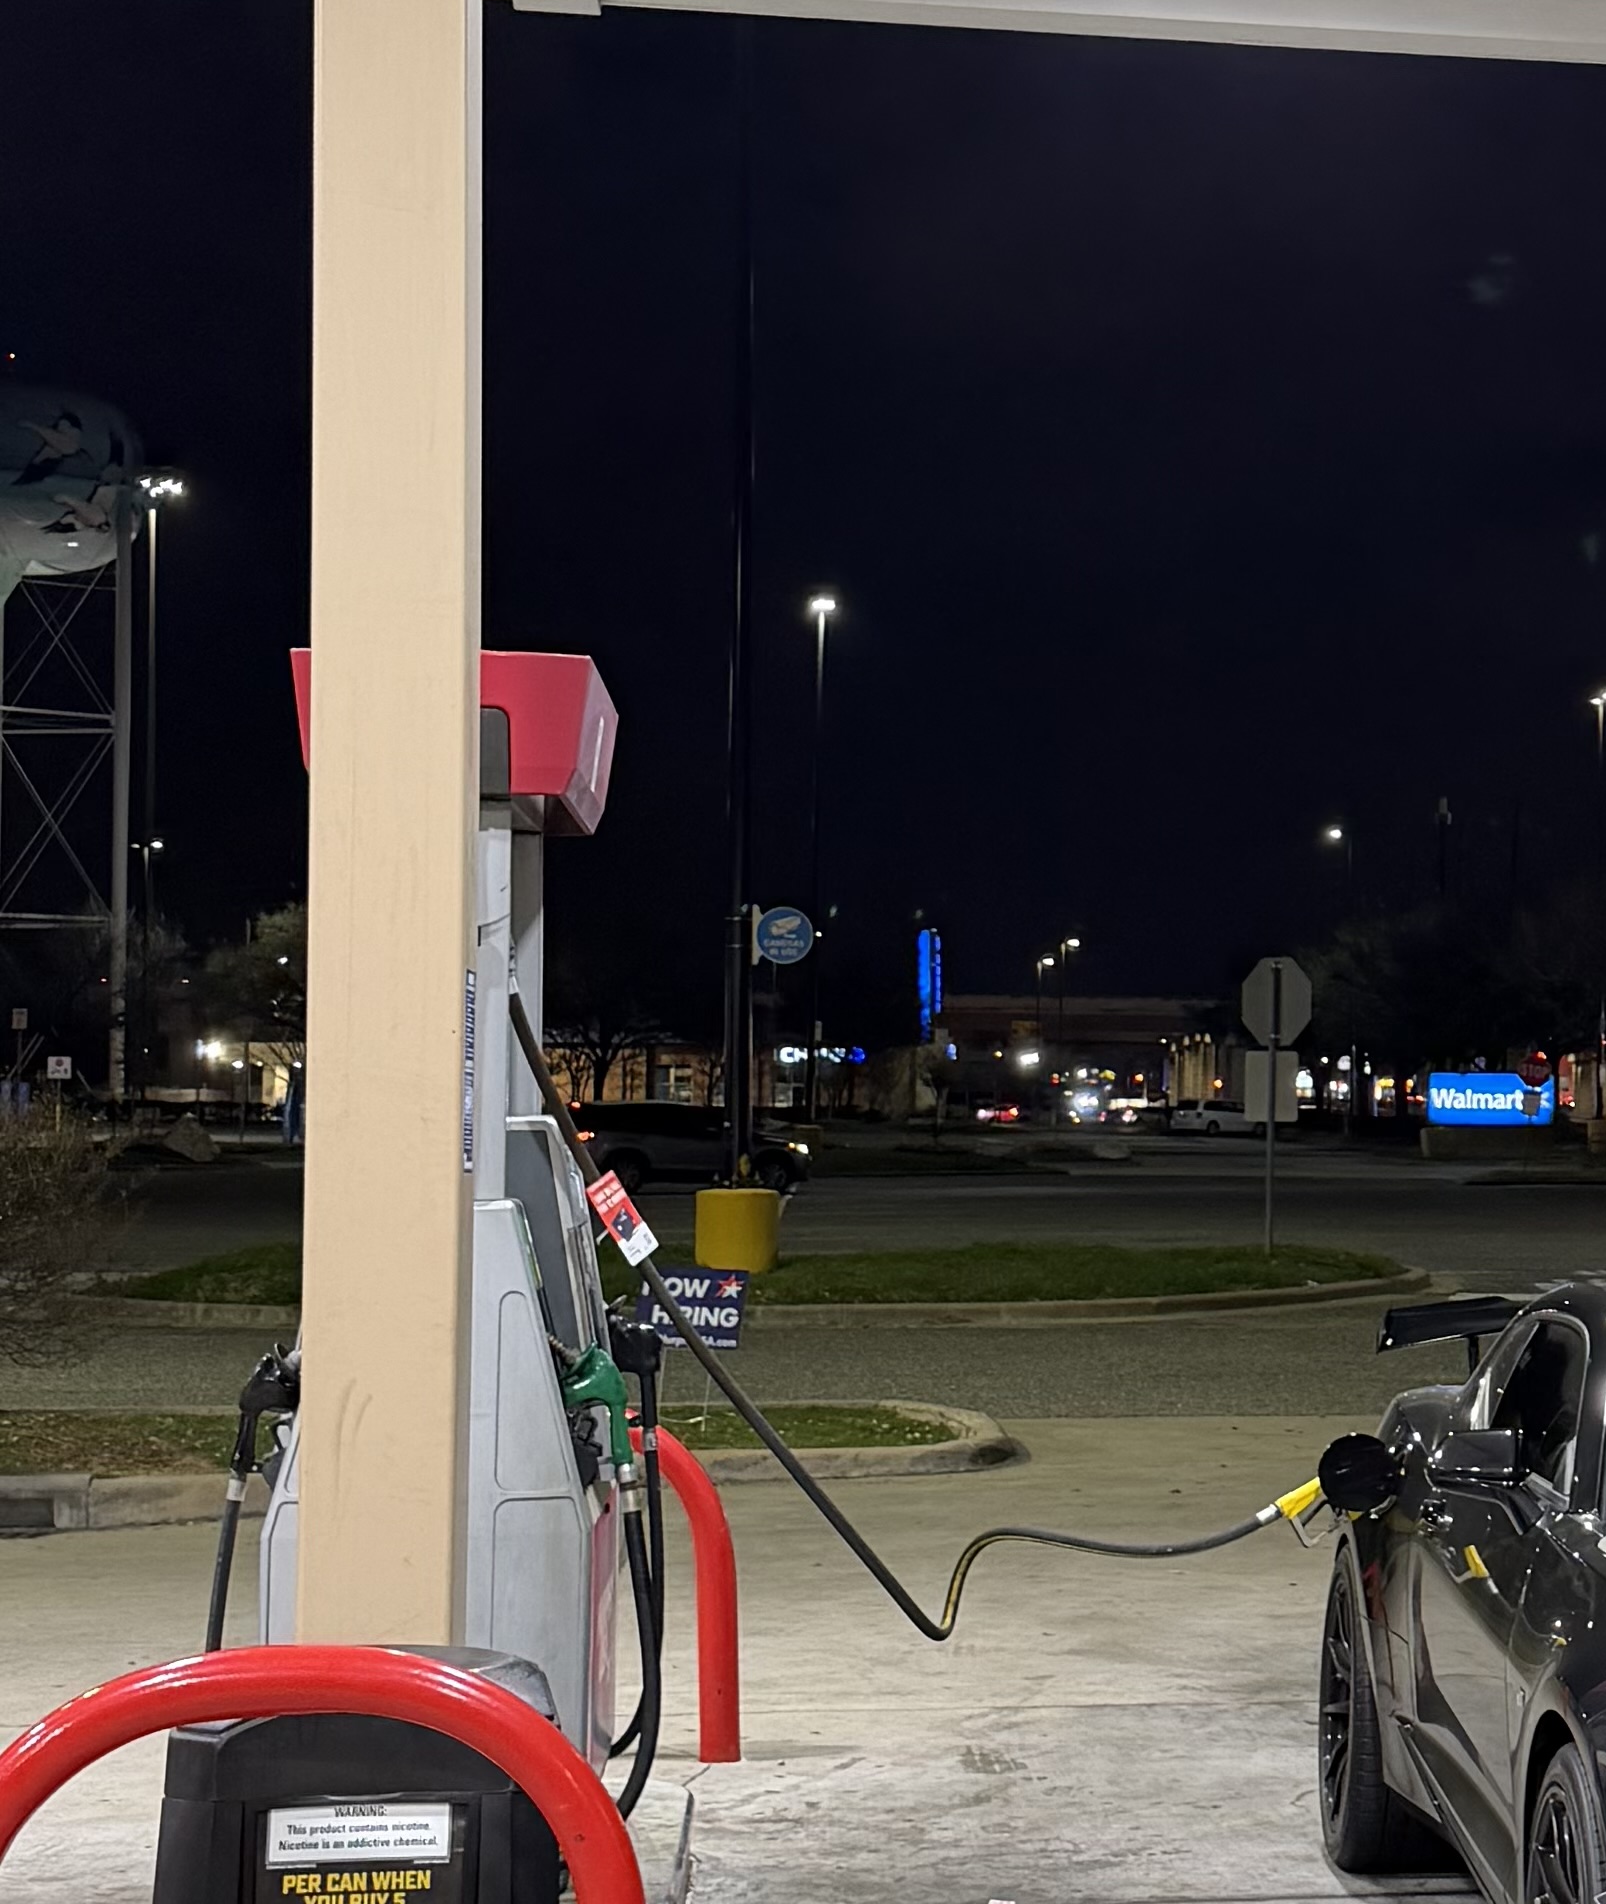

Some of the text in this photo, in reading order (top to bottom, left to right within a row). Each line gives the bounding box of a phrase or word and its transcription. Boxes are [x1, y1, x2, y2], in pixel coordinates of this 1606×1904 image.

[1430, 1088, 1524, 1110] Walmart
[652, 1304, 739, 1327] HRING
[287, 1824, 307, 1835] This
[310, 1824, 345, 1836] product
[279, 1840, 319, 1851] Nicotine
[348, 1837, 390, 1848] addictive
[283, 1870, 431, 1894] PER CAN WHEN
